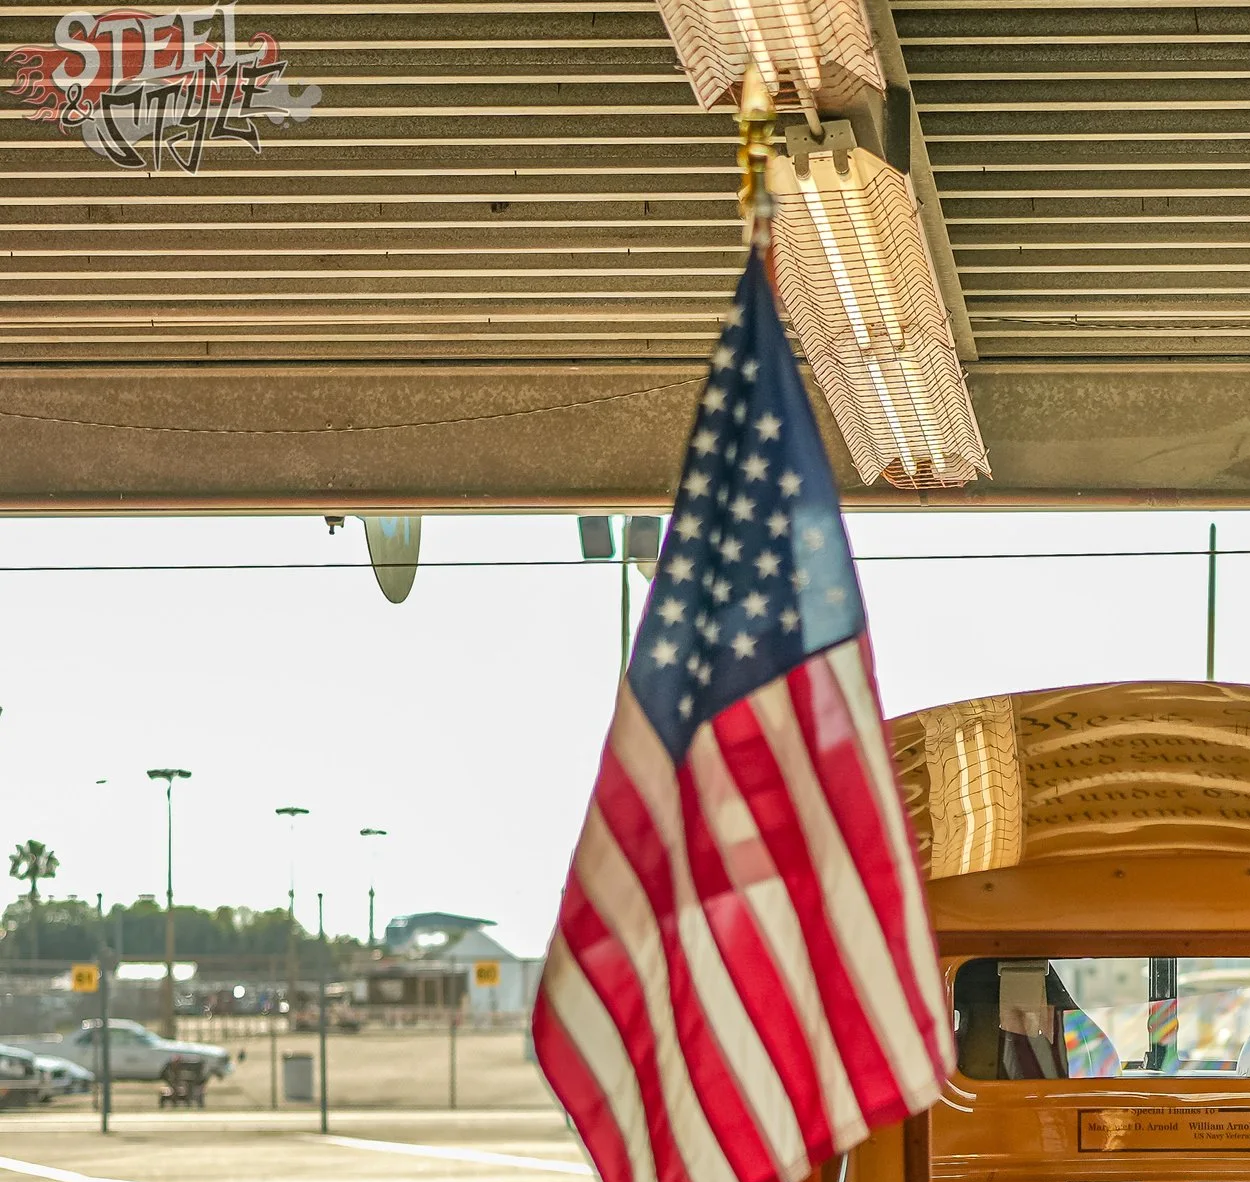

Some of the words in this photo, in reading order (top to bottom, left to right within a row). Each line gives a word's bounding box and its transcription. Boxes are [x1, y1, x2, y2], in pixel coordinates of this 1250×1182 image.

[1134, 1122, 1145, 1131] D.
[1148, 1122, 1179, 1131] Arnold
[1188, 1121, 1224, 1132] William
[1206, 1132, 1224, 1140] Navy
